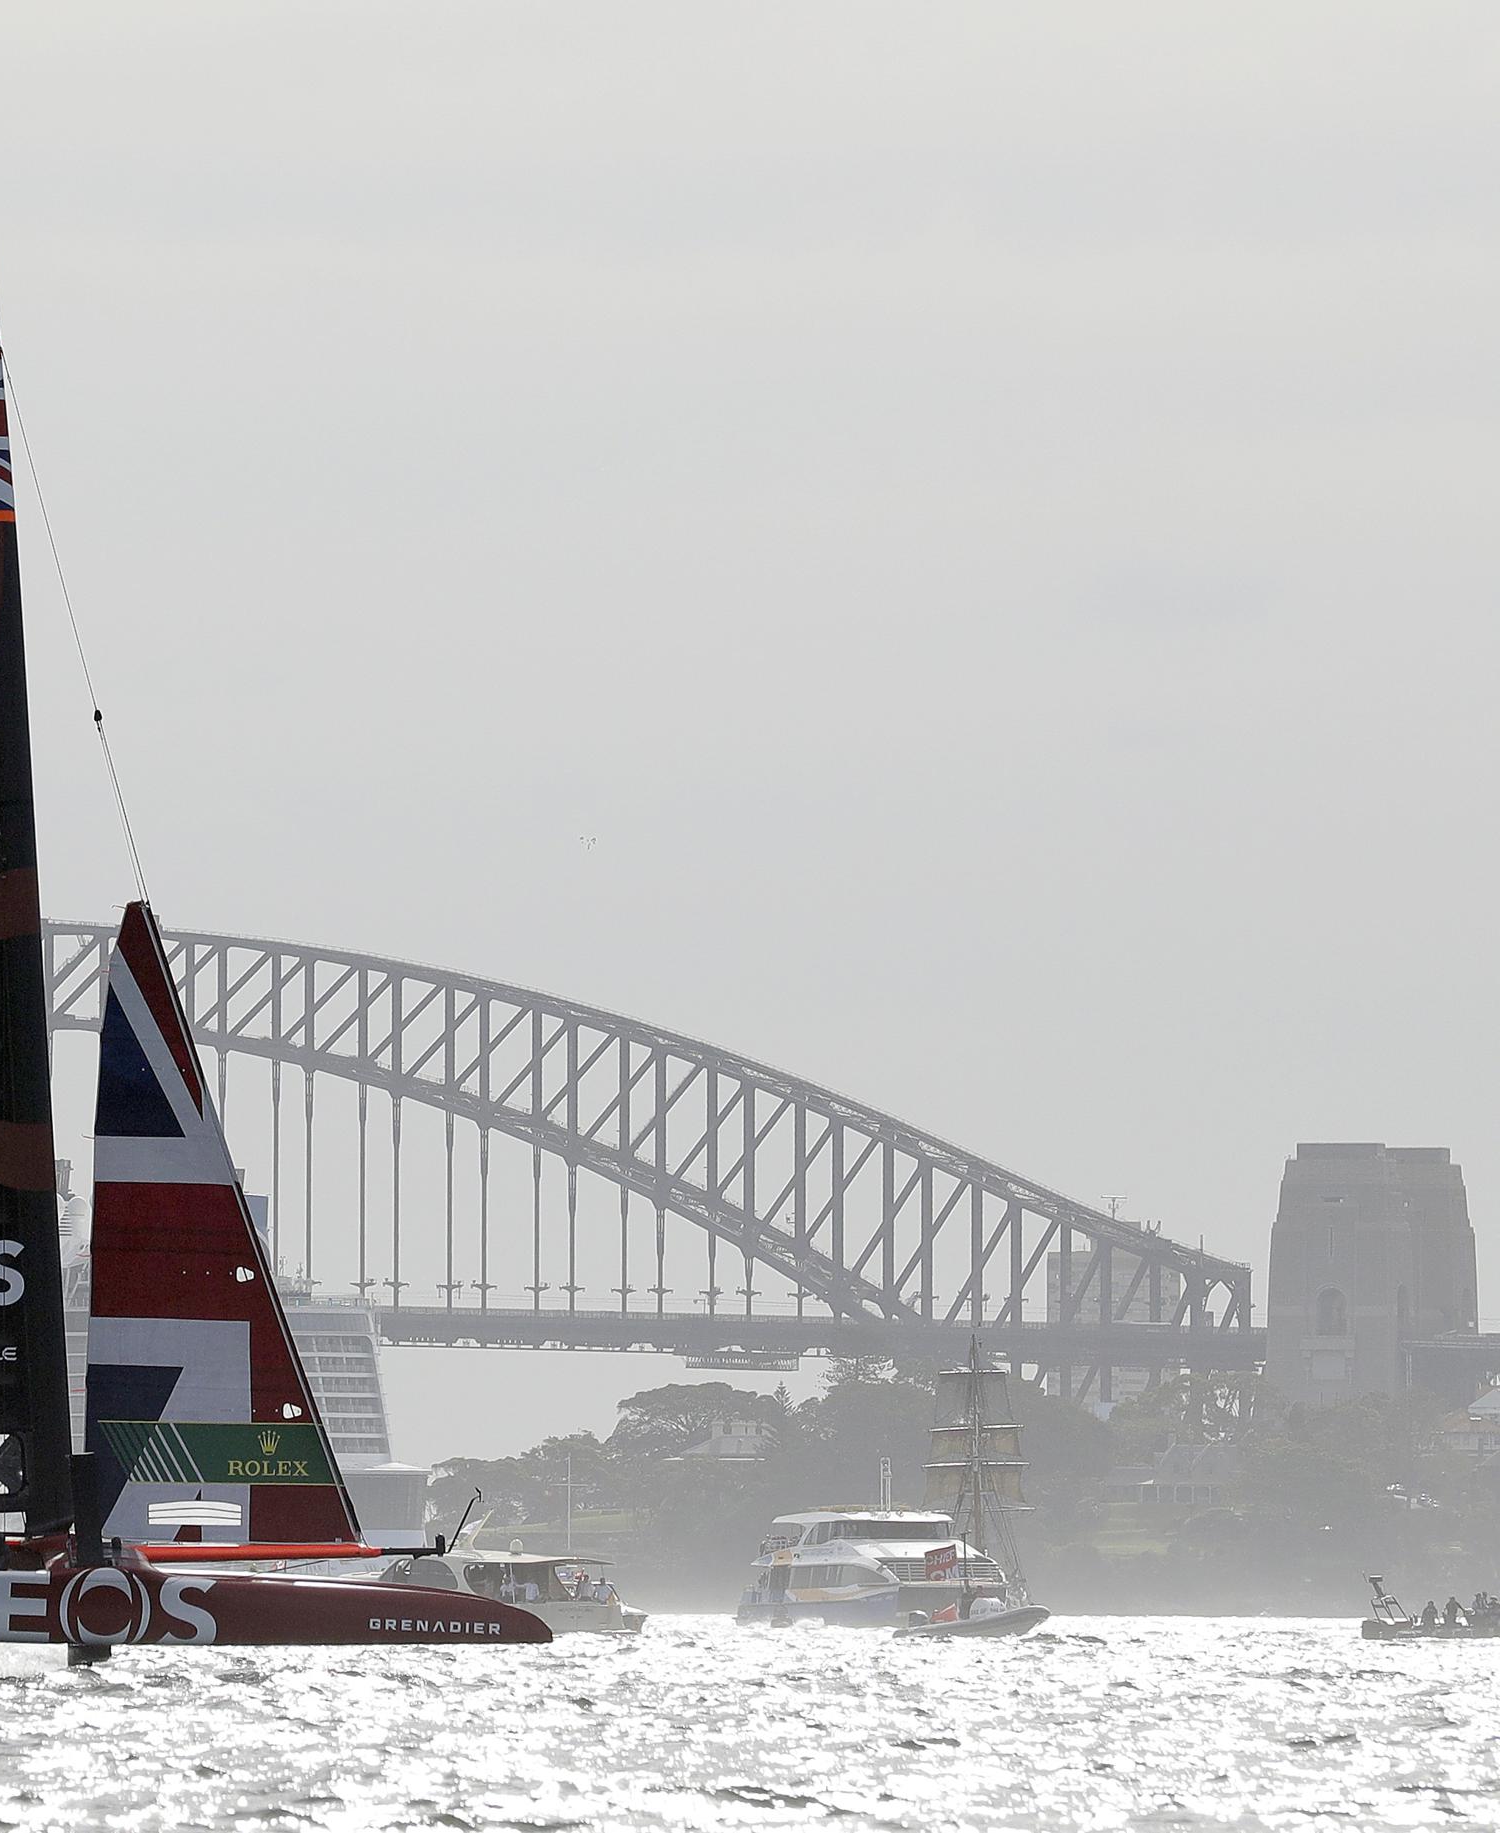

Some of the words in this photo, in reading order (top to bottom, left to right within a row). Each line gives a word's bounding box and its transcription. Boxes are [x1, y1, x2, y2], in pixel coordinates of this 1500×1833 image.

[227, 1460, 310, 1477] ROLEX
[926, 1549, 955, 1566] CHIEF
[369, 1618, 501, 1635] GRENADIER
